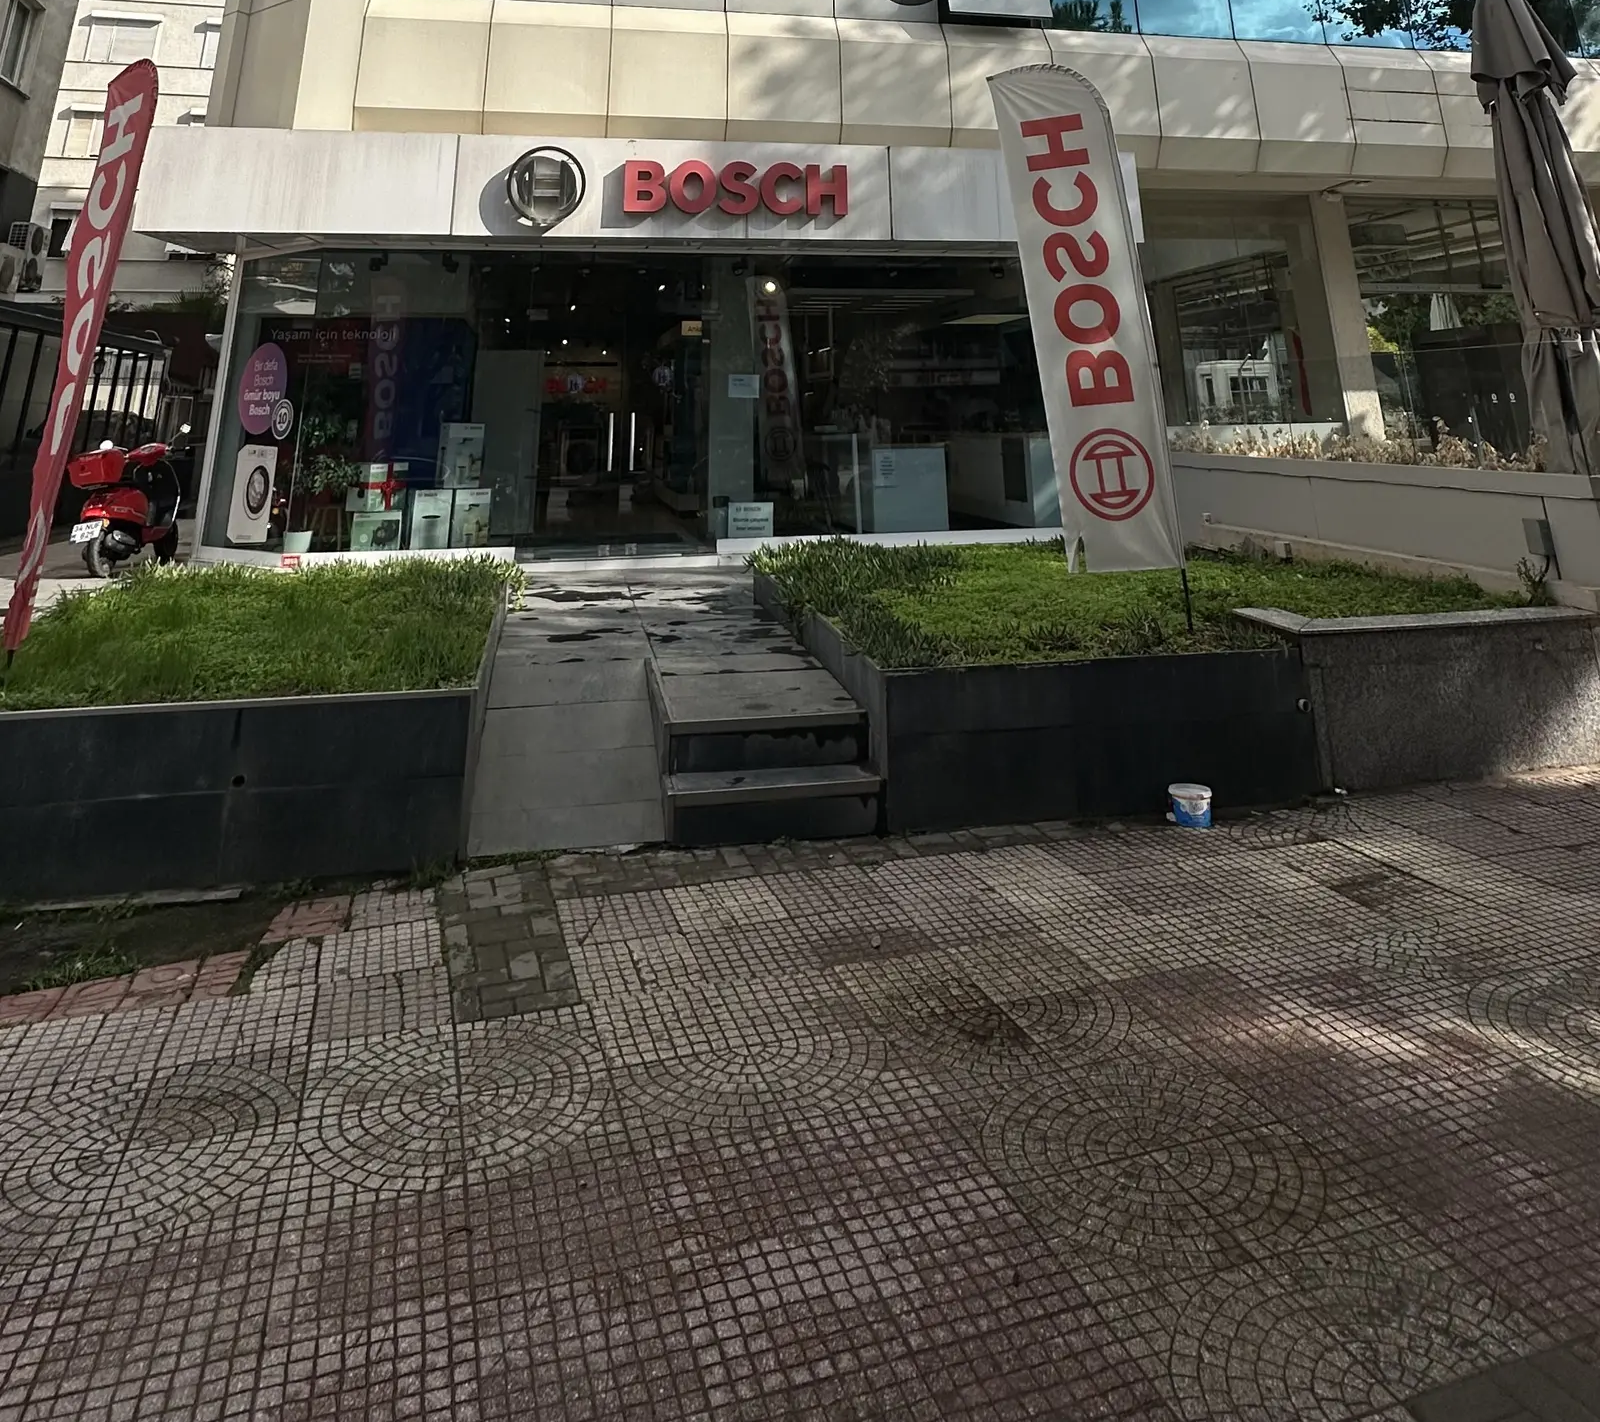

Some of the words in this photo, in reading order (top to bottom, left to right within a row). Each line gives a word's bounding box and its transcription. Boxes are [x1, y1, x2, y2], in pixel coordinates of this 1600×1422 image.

[623, 159, 849, 217] BOSCH
[270, 328, 311, 343] Yaşam
[315, 328, 338, 343] için
[342, 328, 397, 342] teknoloji
[254, 360, 264, 371] Bir
[263, 359, 278, 371] defa
[253, 374, 274, 386] Bosch
[243, 389, 263, 401] ömür
[262, 389, 281, 402] boyu
[248, 403, 270, 416] Bosch
[278, 412, 288, 425] 10
